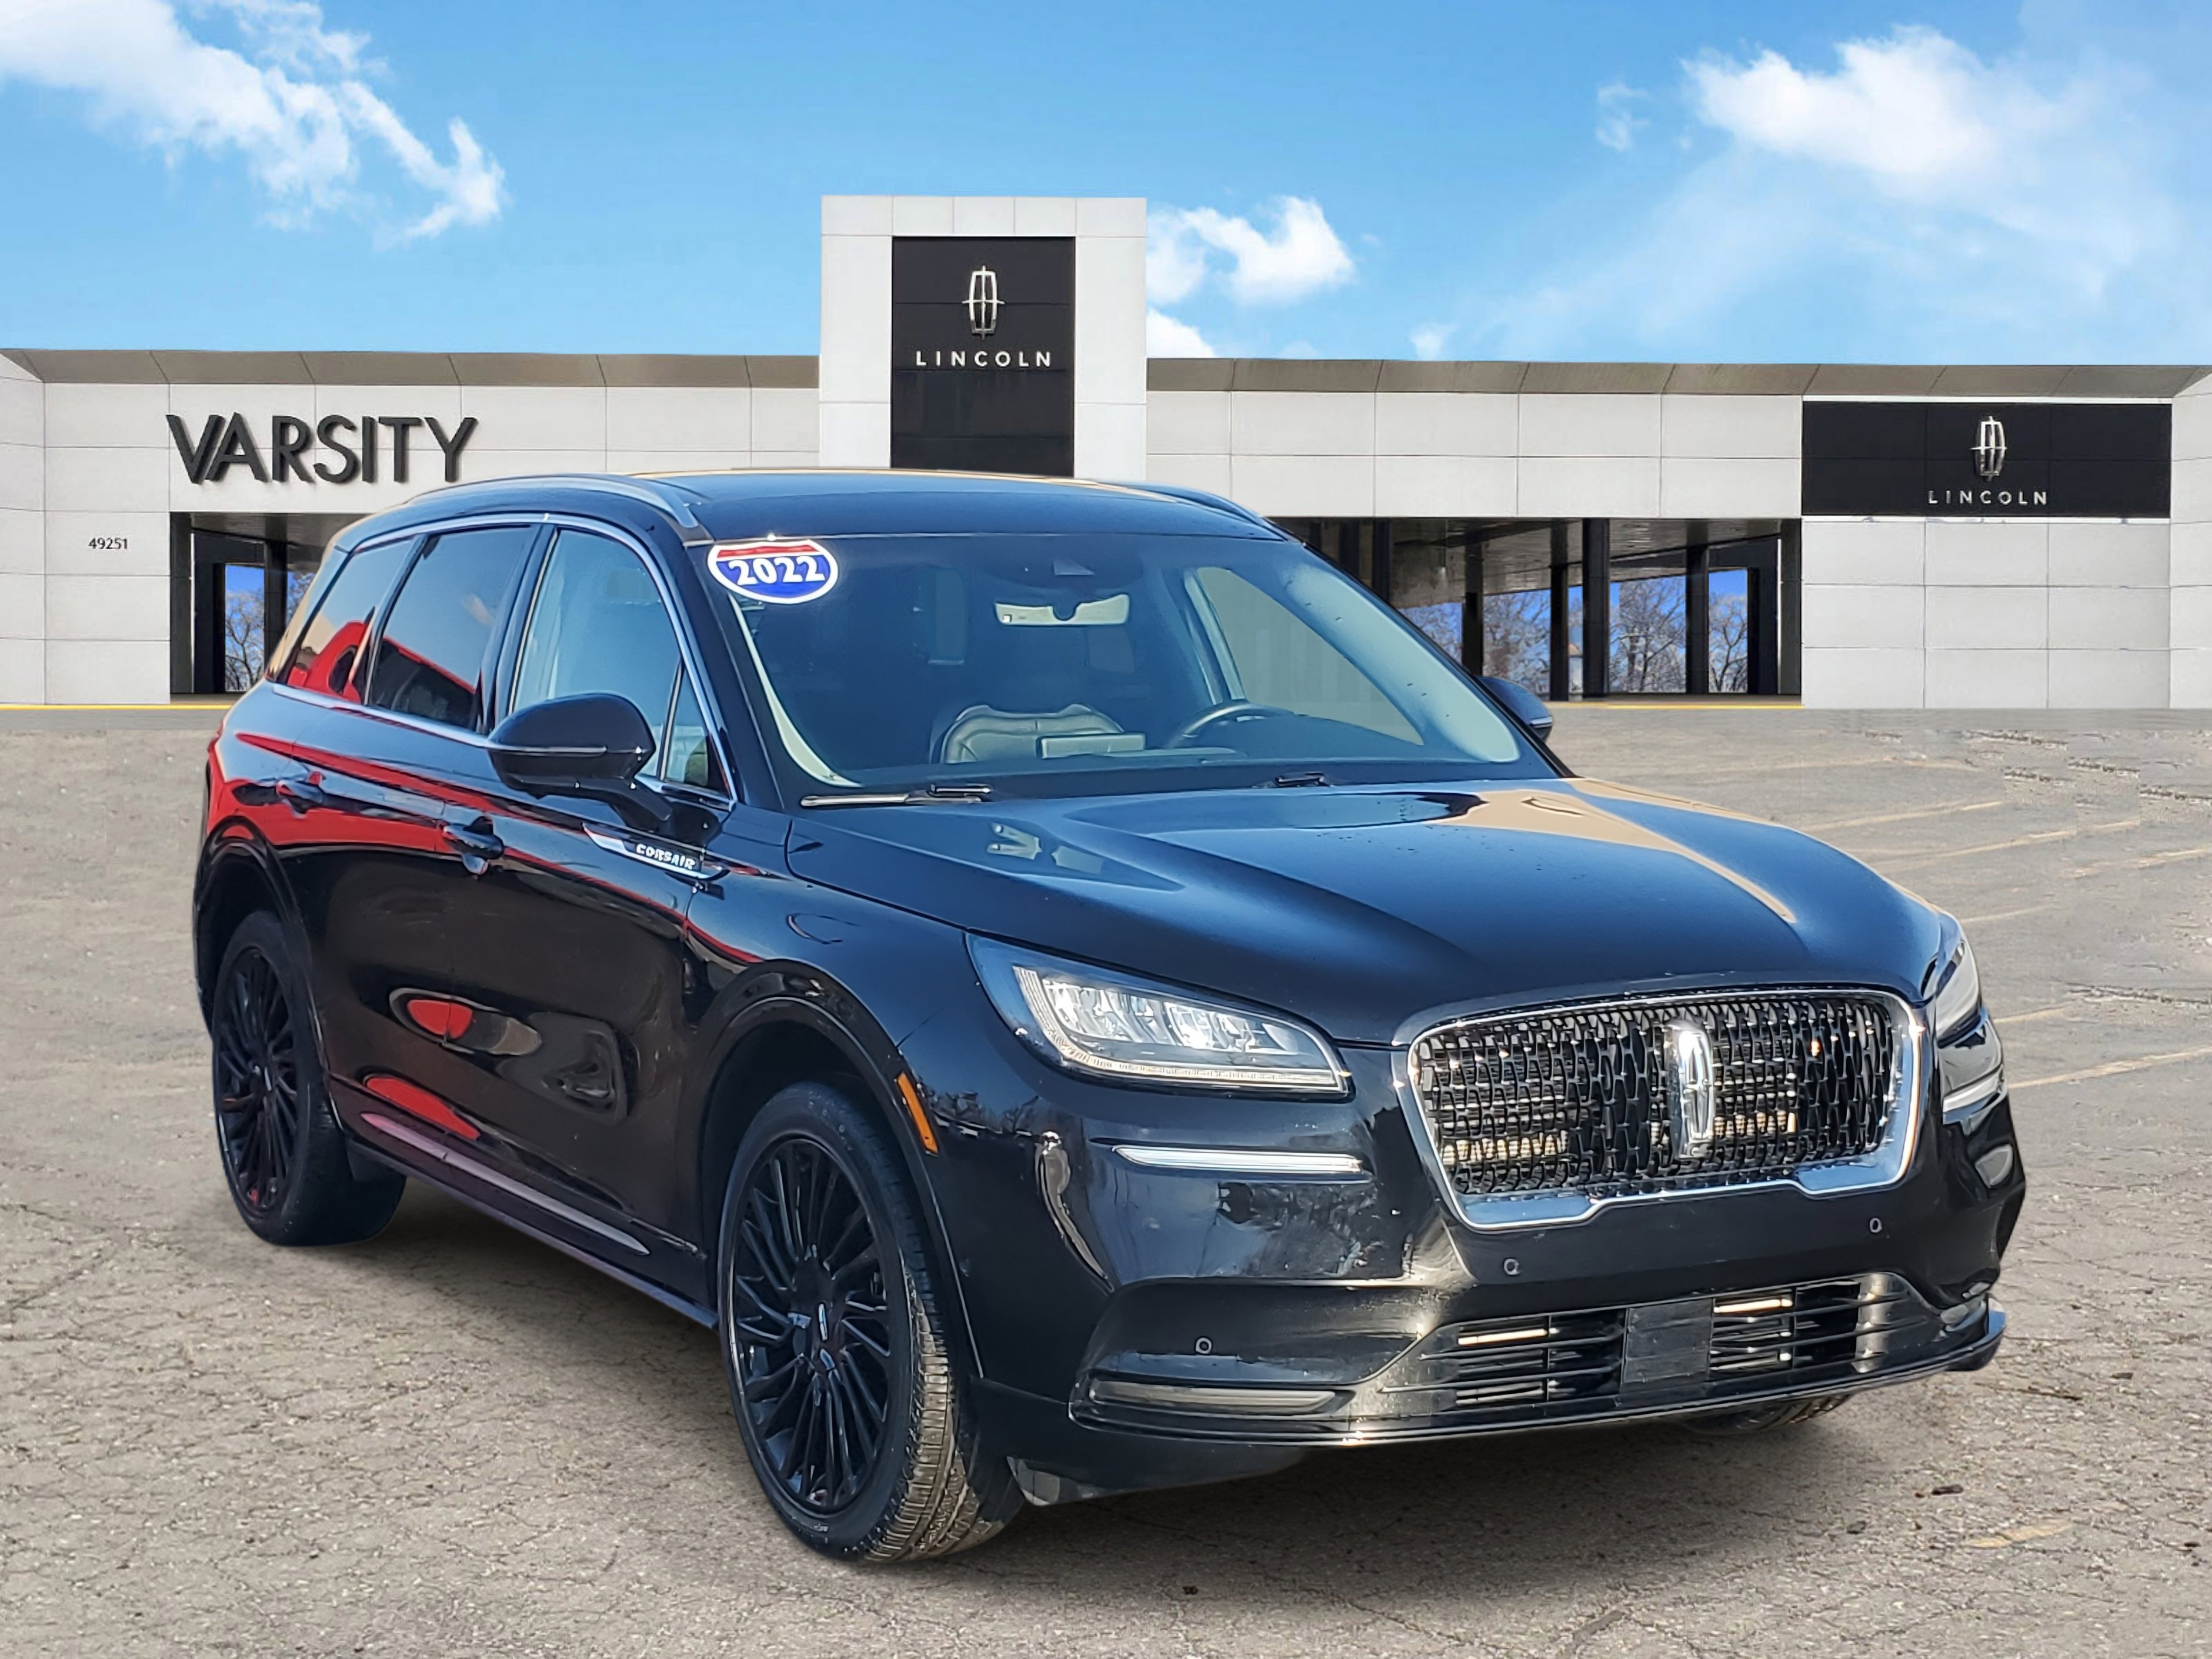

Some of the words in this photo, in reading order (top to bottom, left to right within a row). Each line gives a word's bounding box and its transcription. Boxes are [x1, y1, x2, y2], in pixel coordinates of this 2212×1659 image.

[916, 351, 1050, 367] LINCOLN
[166, 412, 478, 484] VARSITY
[1928, 490, 2047, 505] LINCOLN
[88, 538, 128, 549] 49251
[728, 556, 825, 585] 2022
[636, 843, 695, 870] CORSAIR
